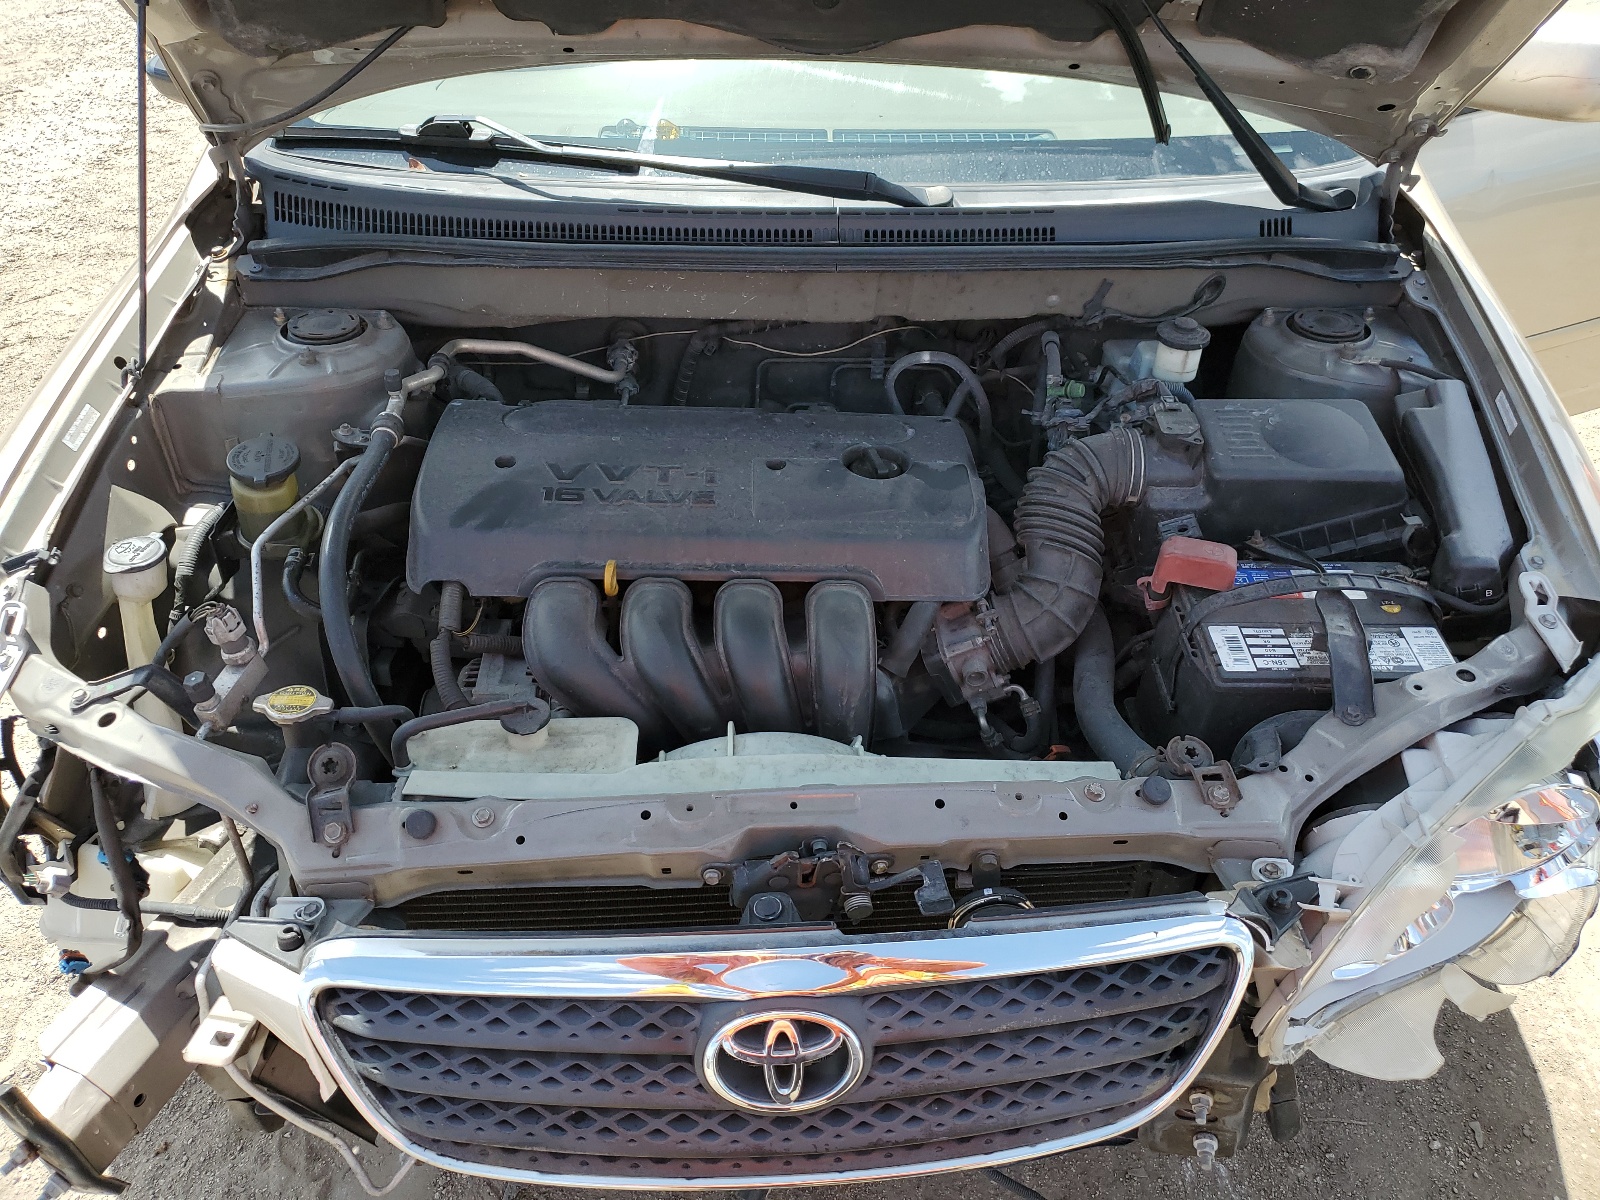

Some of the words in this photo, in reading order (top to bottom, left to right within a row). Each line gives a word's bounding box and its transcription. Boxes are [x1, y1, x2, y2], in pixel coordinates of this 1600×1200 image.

[543, 486, 586, 504] 16
[591, 488, 717, 507] VALVE
[1485, 589, 1493, 597] B
